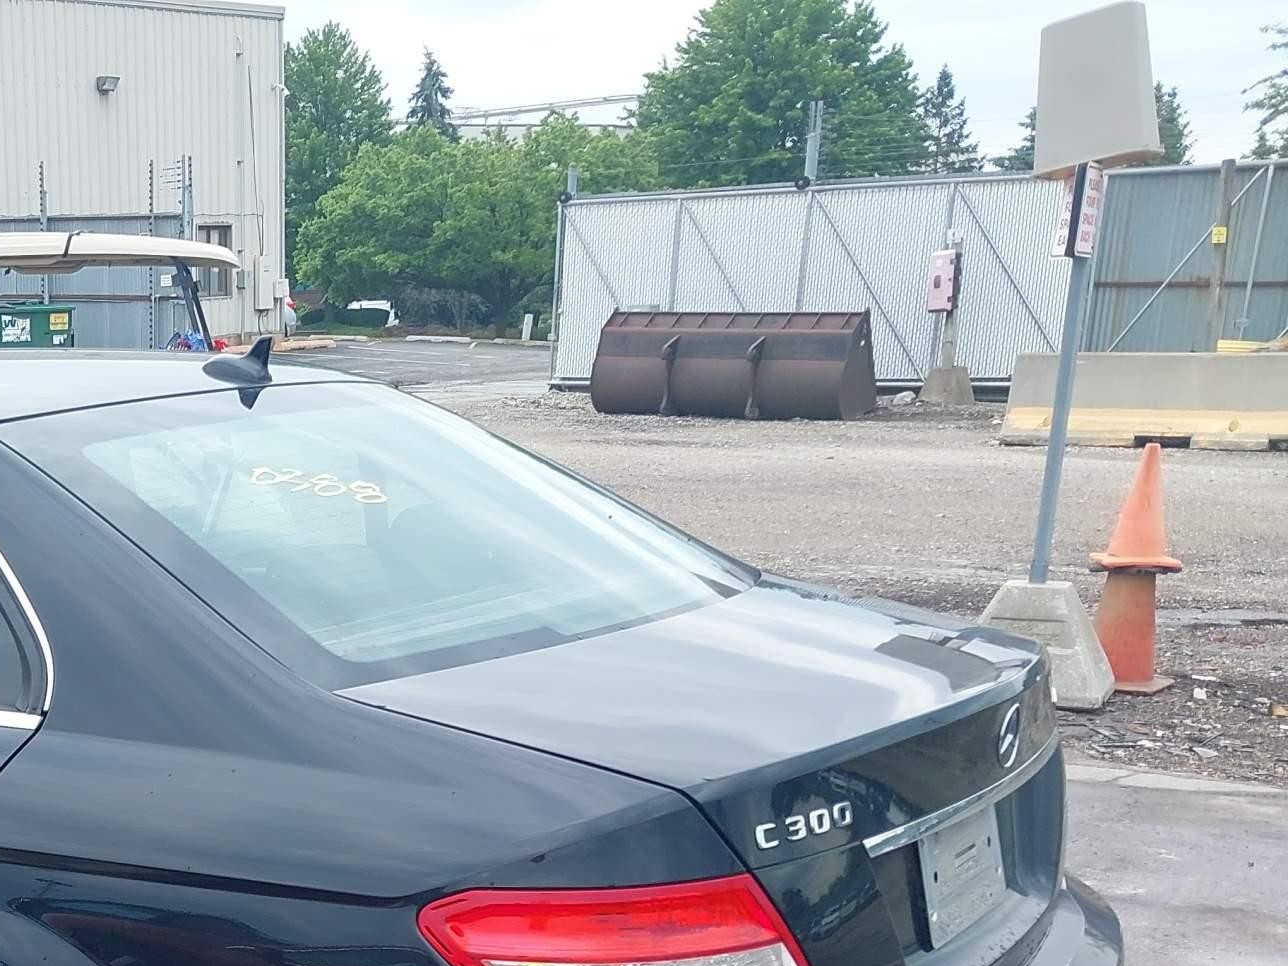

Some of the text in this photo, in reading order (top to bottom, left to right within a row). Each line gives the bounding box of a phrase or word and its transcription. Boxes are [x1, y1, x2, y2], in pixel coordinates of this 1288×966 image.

[251, 467, 387, 504] 0388
[755, 801, 853, 850] C 300
